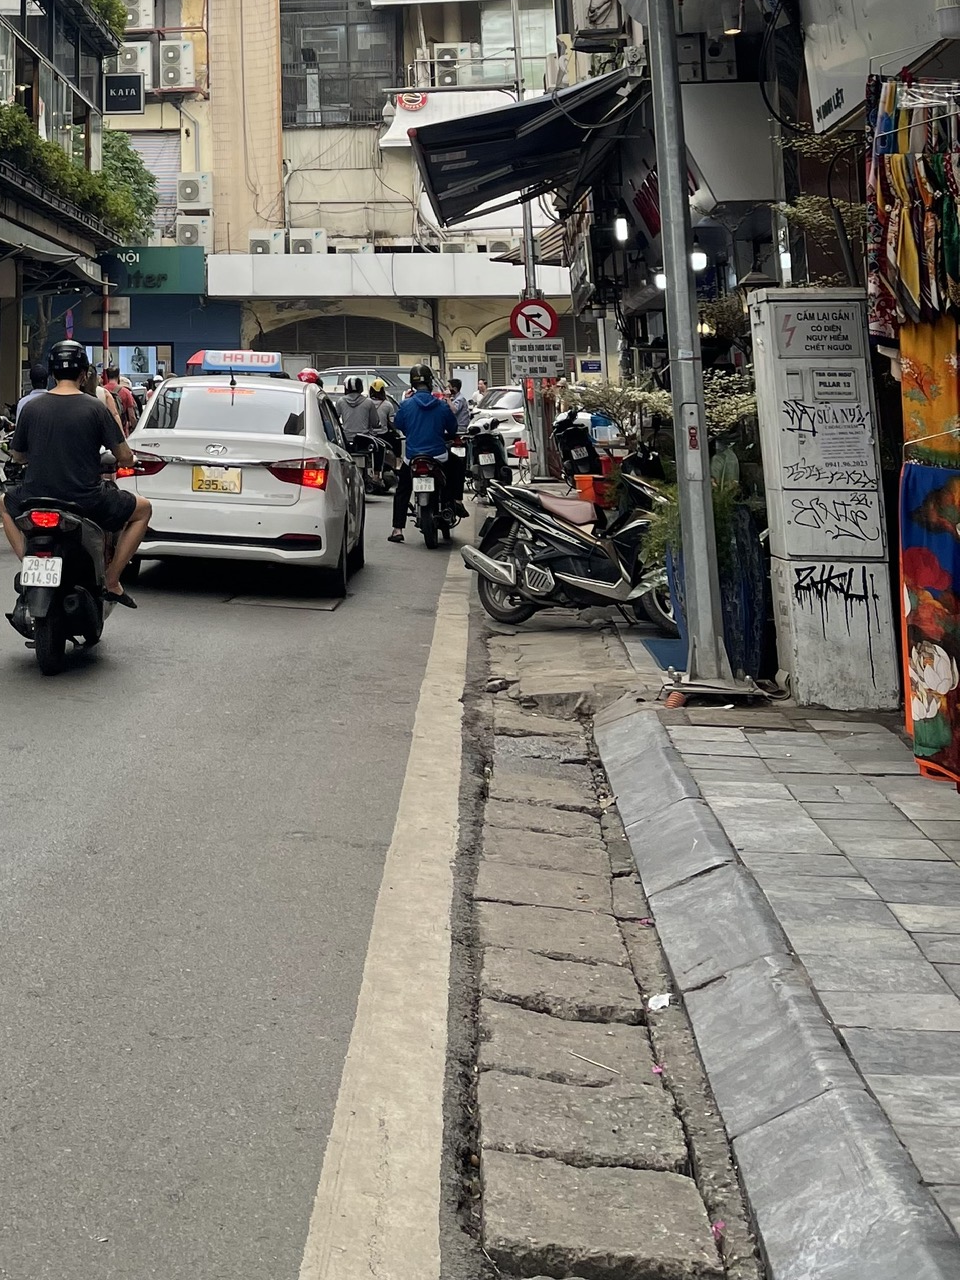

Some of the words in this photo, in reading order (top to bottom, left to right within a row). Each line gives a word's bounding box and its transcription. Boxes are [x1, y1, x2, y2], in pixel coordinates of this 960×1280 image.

[816, 312, 830, 323] LẠI
[27, 559, 56, 572] 29-C2
[22, 571, 58, 585] 014.96
